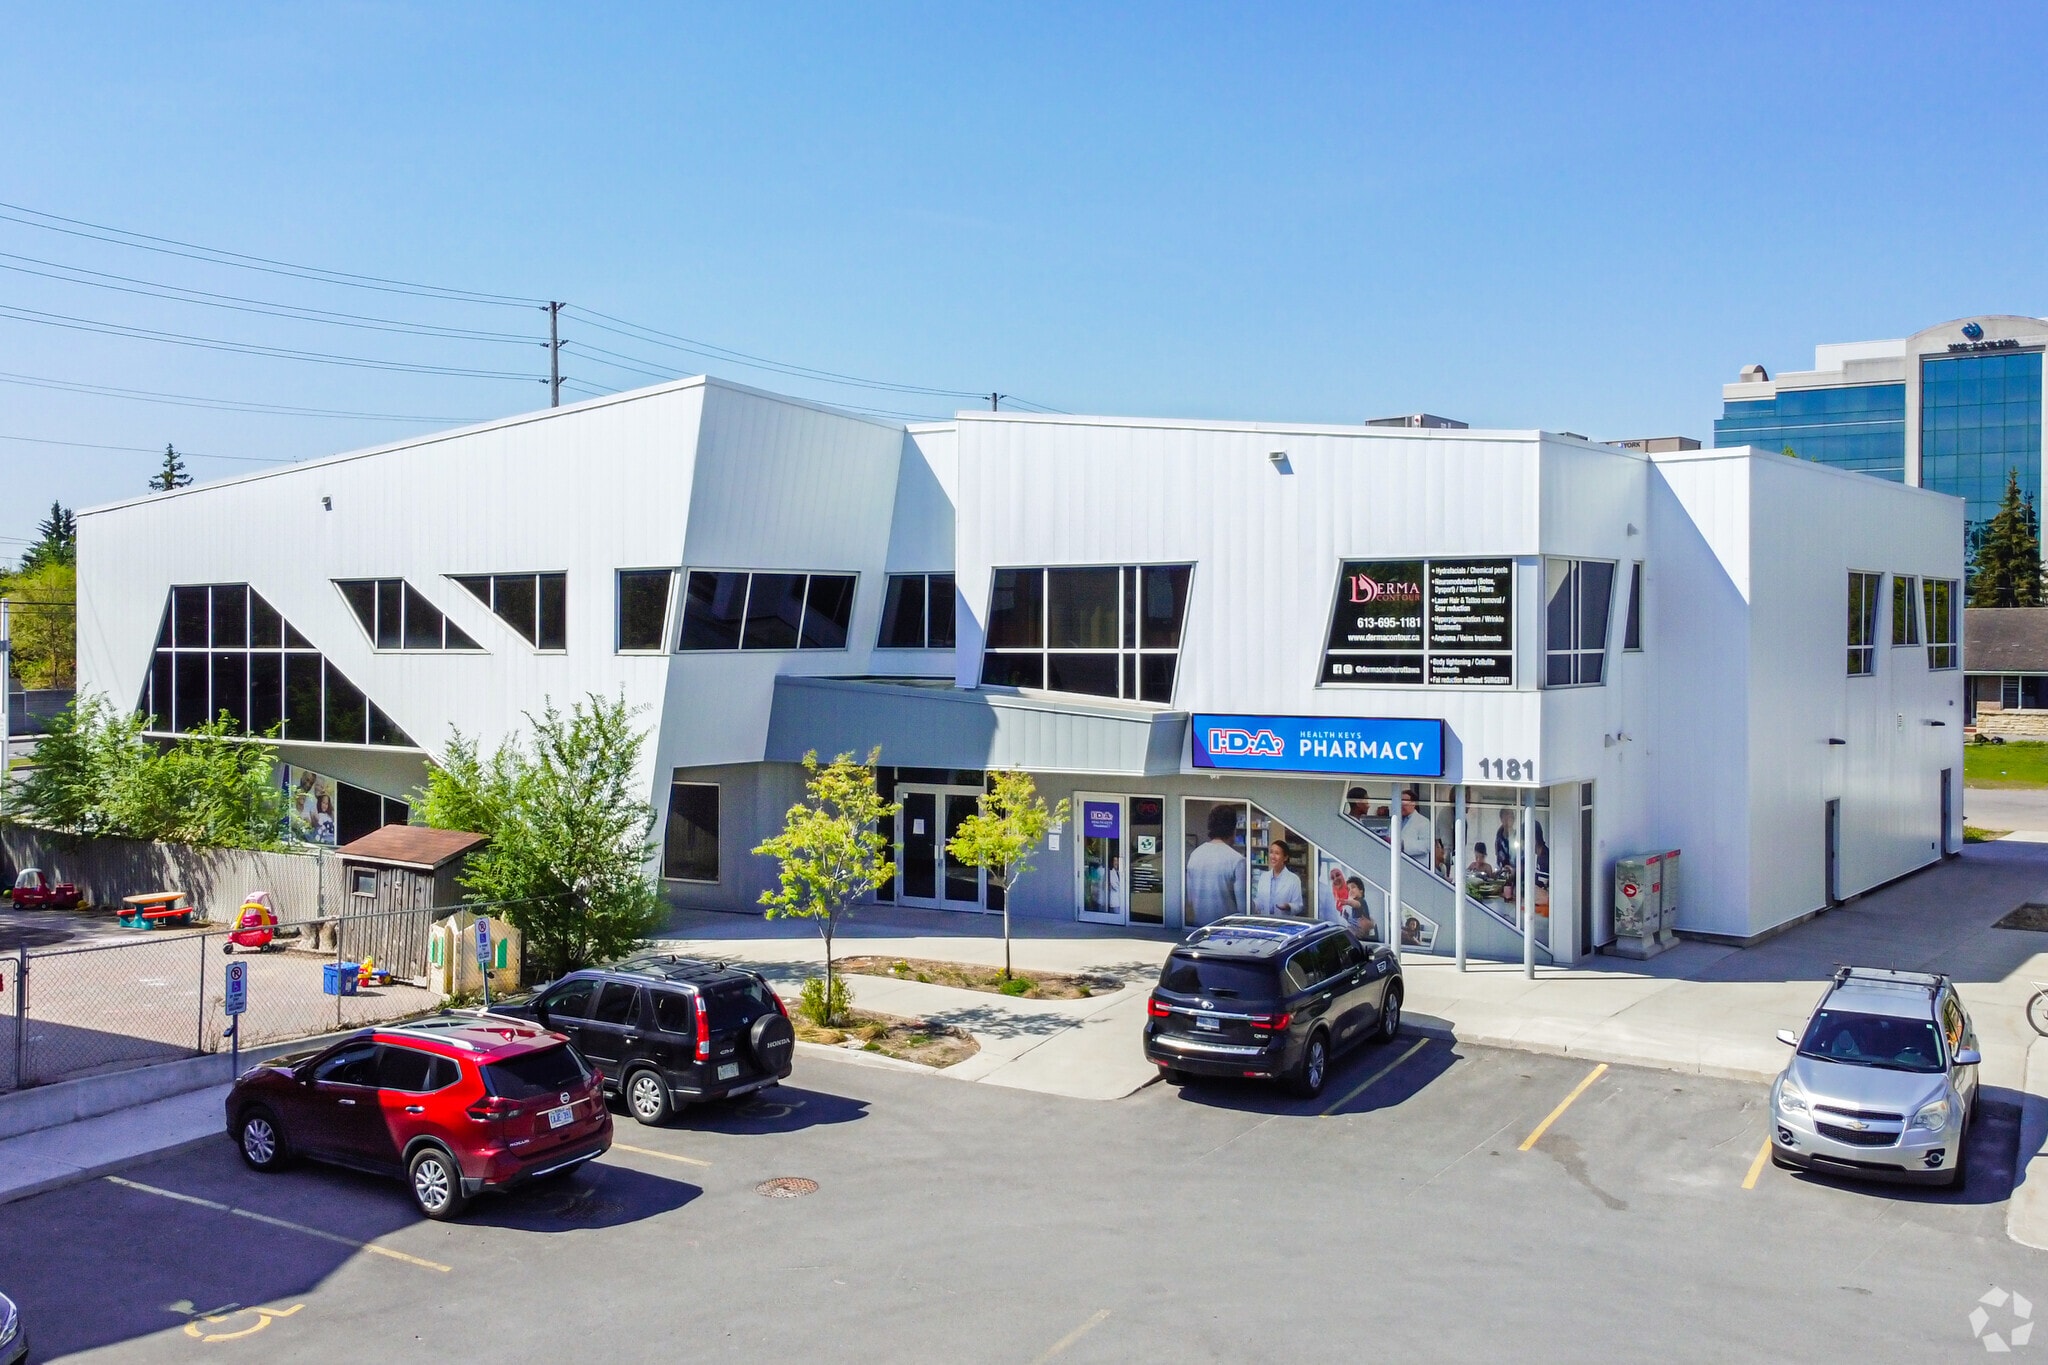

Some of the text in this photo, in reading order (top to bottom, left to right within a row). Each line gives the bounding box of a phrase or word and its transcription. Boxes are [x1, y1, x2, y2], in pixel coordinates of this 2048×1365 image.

[1349, 573, 1419, 602] DERMA
[1482, 596, 1501, 604] removal
[1357, 617, 1420, 628] 613-695-1181
[1485, 615, 1504, 623] Wrinkle
[1348, 633, 1420, 641] www.dermacontour.ca
[1441, 676, 1463, 684] reduction
[1464, 676, 1483, 684] without
[1300, 731, 1334, 739] HEALTH
[1299, 739, 1424, 761] PHARMACY
[1478, 757, 1533, 781] 1181
[766, 1038, 791, 1049] HONDA
